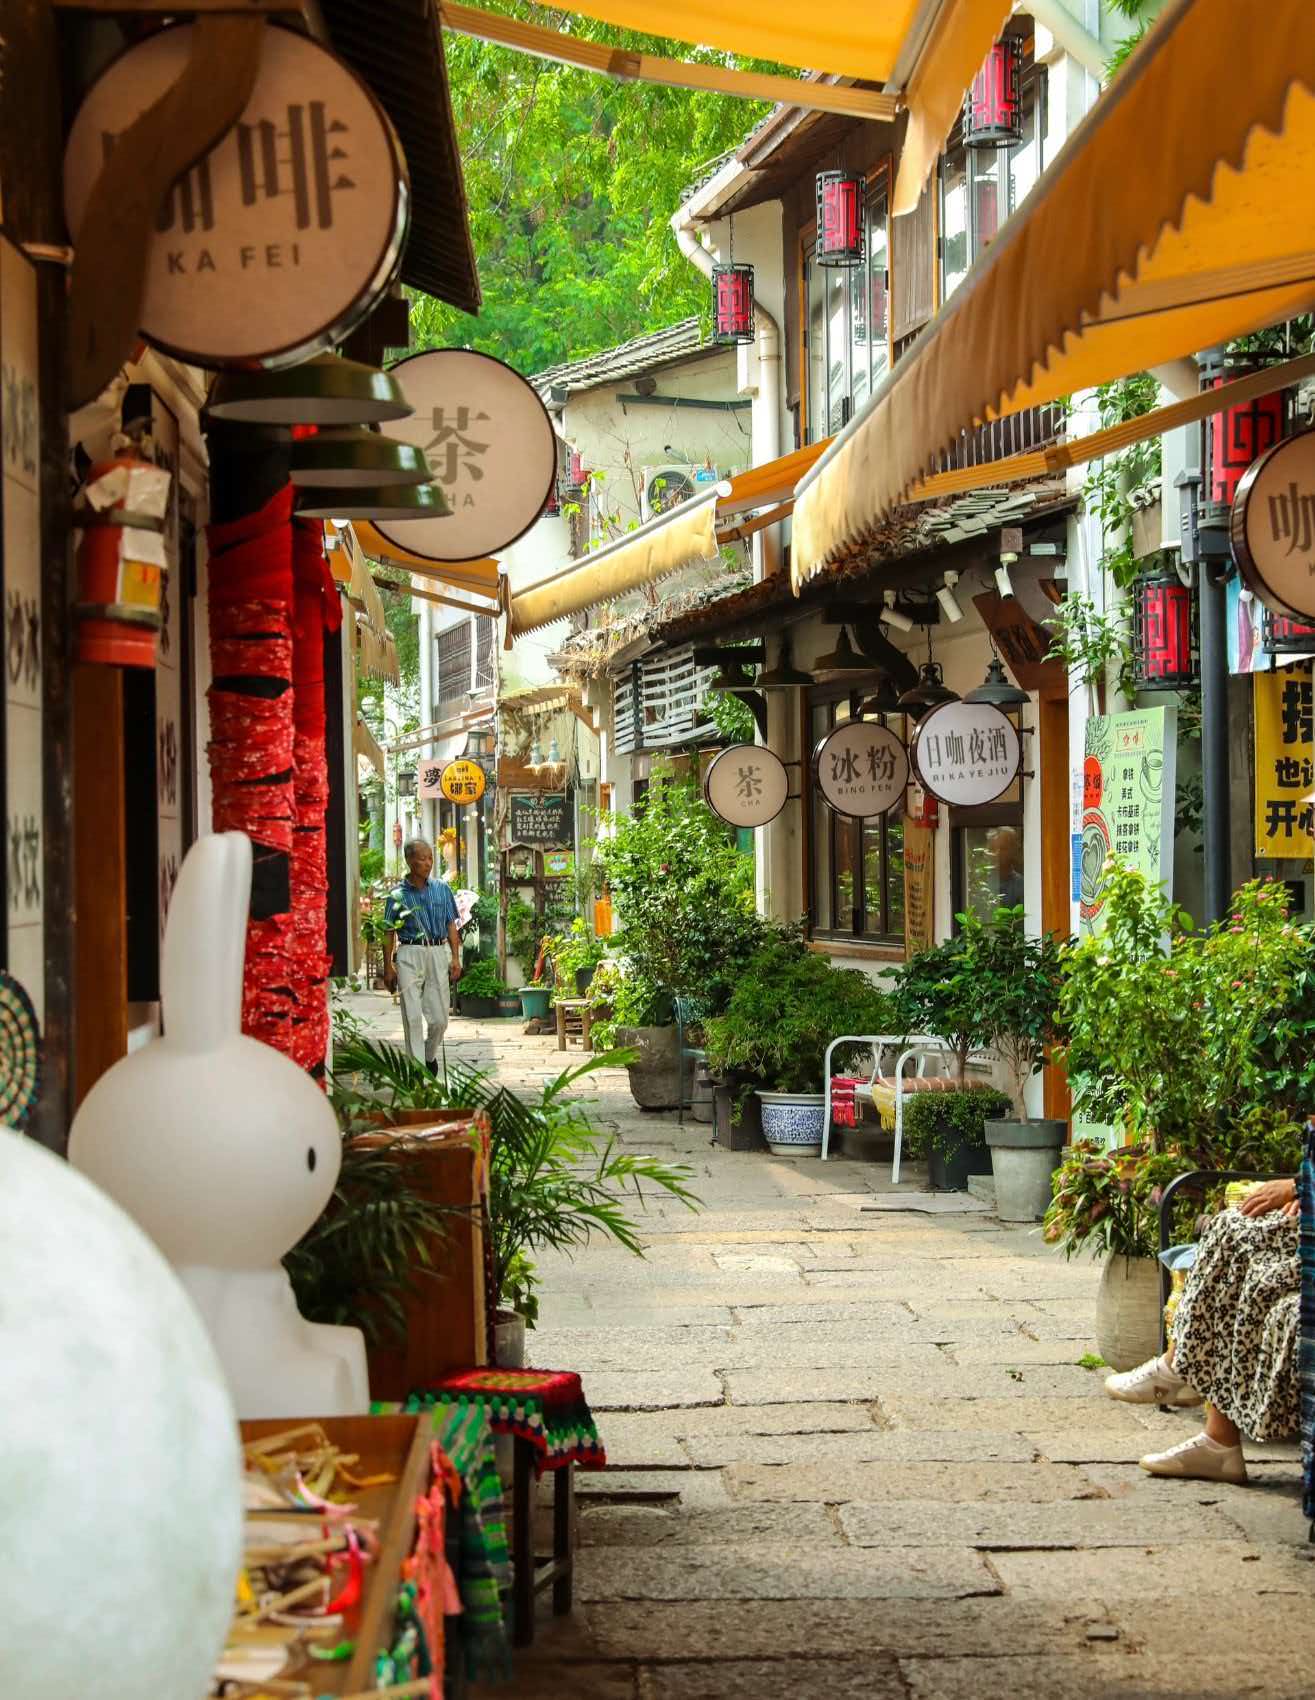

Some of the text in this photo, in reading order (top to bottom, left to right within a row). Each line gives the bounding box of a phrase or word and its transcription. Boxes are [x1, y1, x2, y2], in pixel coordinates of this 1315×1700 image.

[167, 243, 300, 275] KA FEI
[413, 406, 492, 485] 茶
[830, 744, 897, 784] 冰粉
[927, 725, 1008, 769] 日咖夜酒
[732, 765, 763, 798] 茶
[871, 784, 892, 793] FEN
